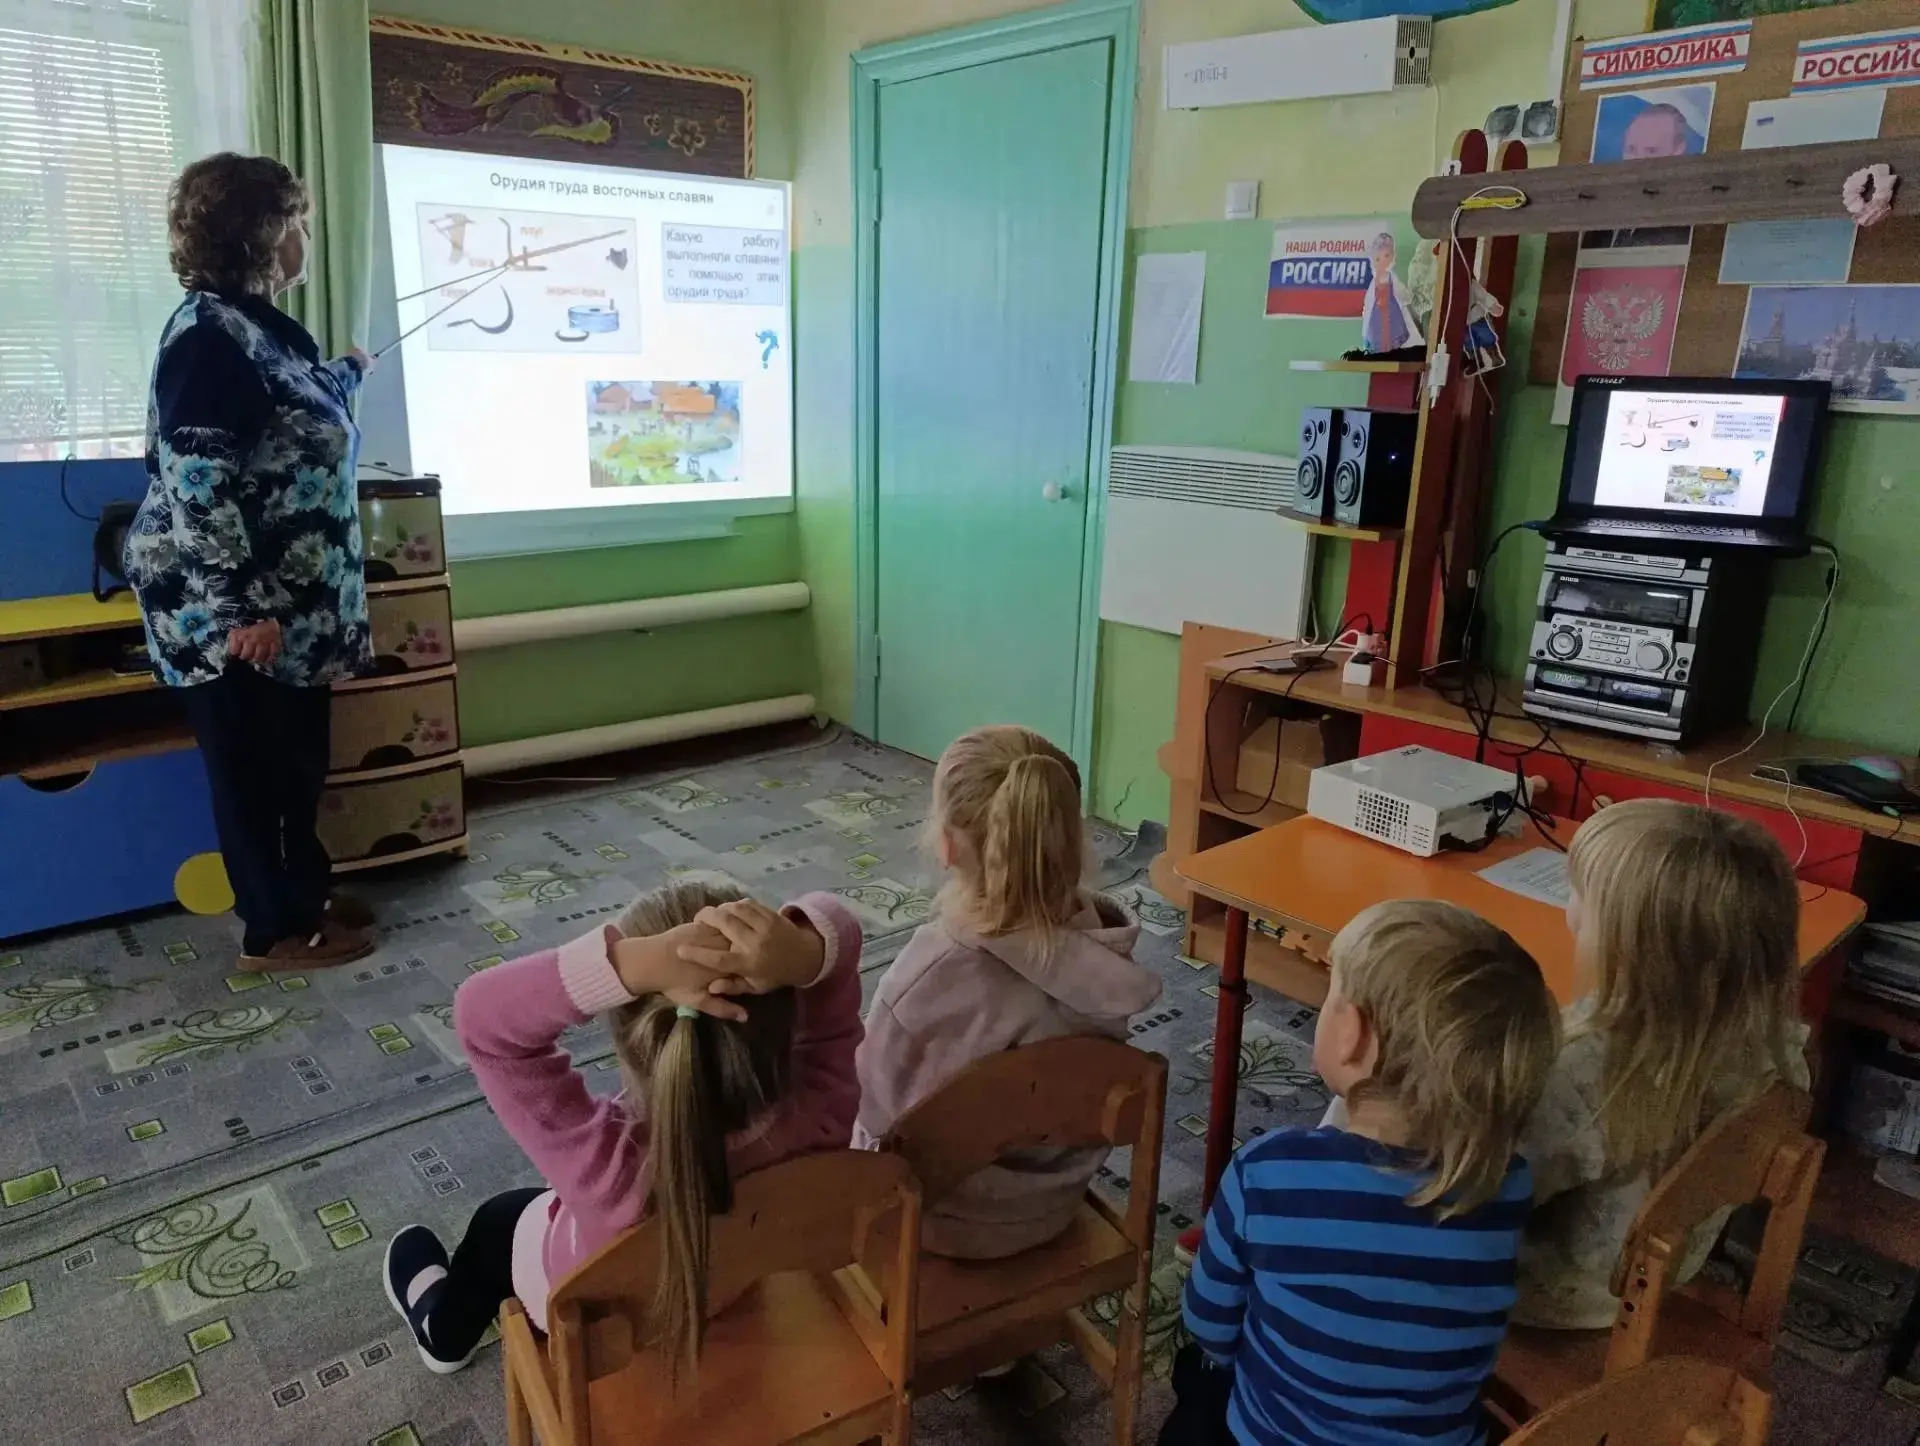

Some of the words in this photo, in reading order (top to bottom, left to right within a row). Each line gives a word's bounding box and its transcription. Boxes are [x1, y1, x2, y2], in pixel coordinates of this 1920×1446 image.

[1592, 37, 1738, 74] СИМВОЛИКА
[490, 172, 546, 190] Орудия
[549, 179, 588, 195] труда
[593, 184, 666, 200] восточных
[669, 190, 714, 204] славян
[666, 229, 703, 243] Какую
[742, 233, 780, 249] работу
[1286, 241, 1317, 253] НАША
[1320, 240, 1365, 254] РОДИНА
[1281, 261, 1367, 285] РОССИЯ!
